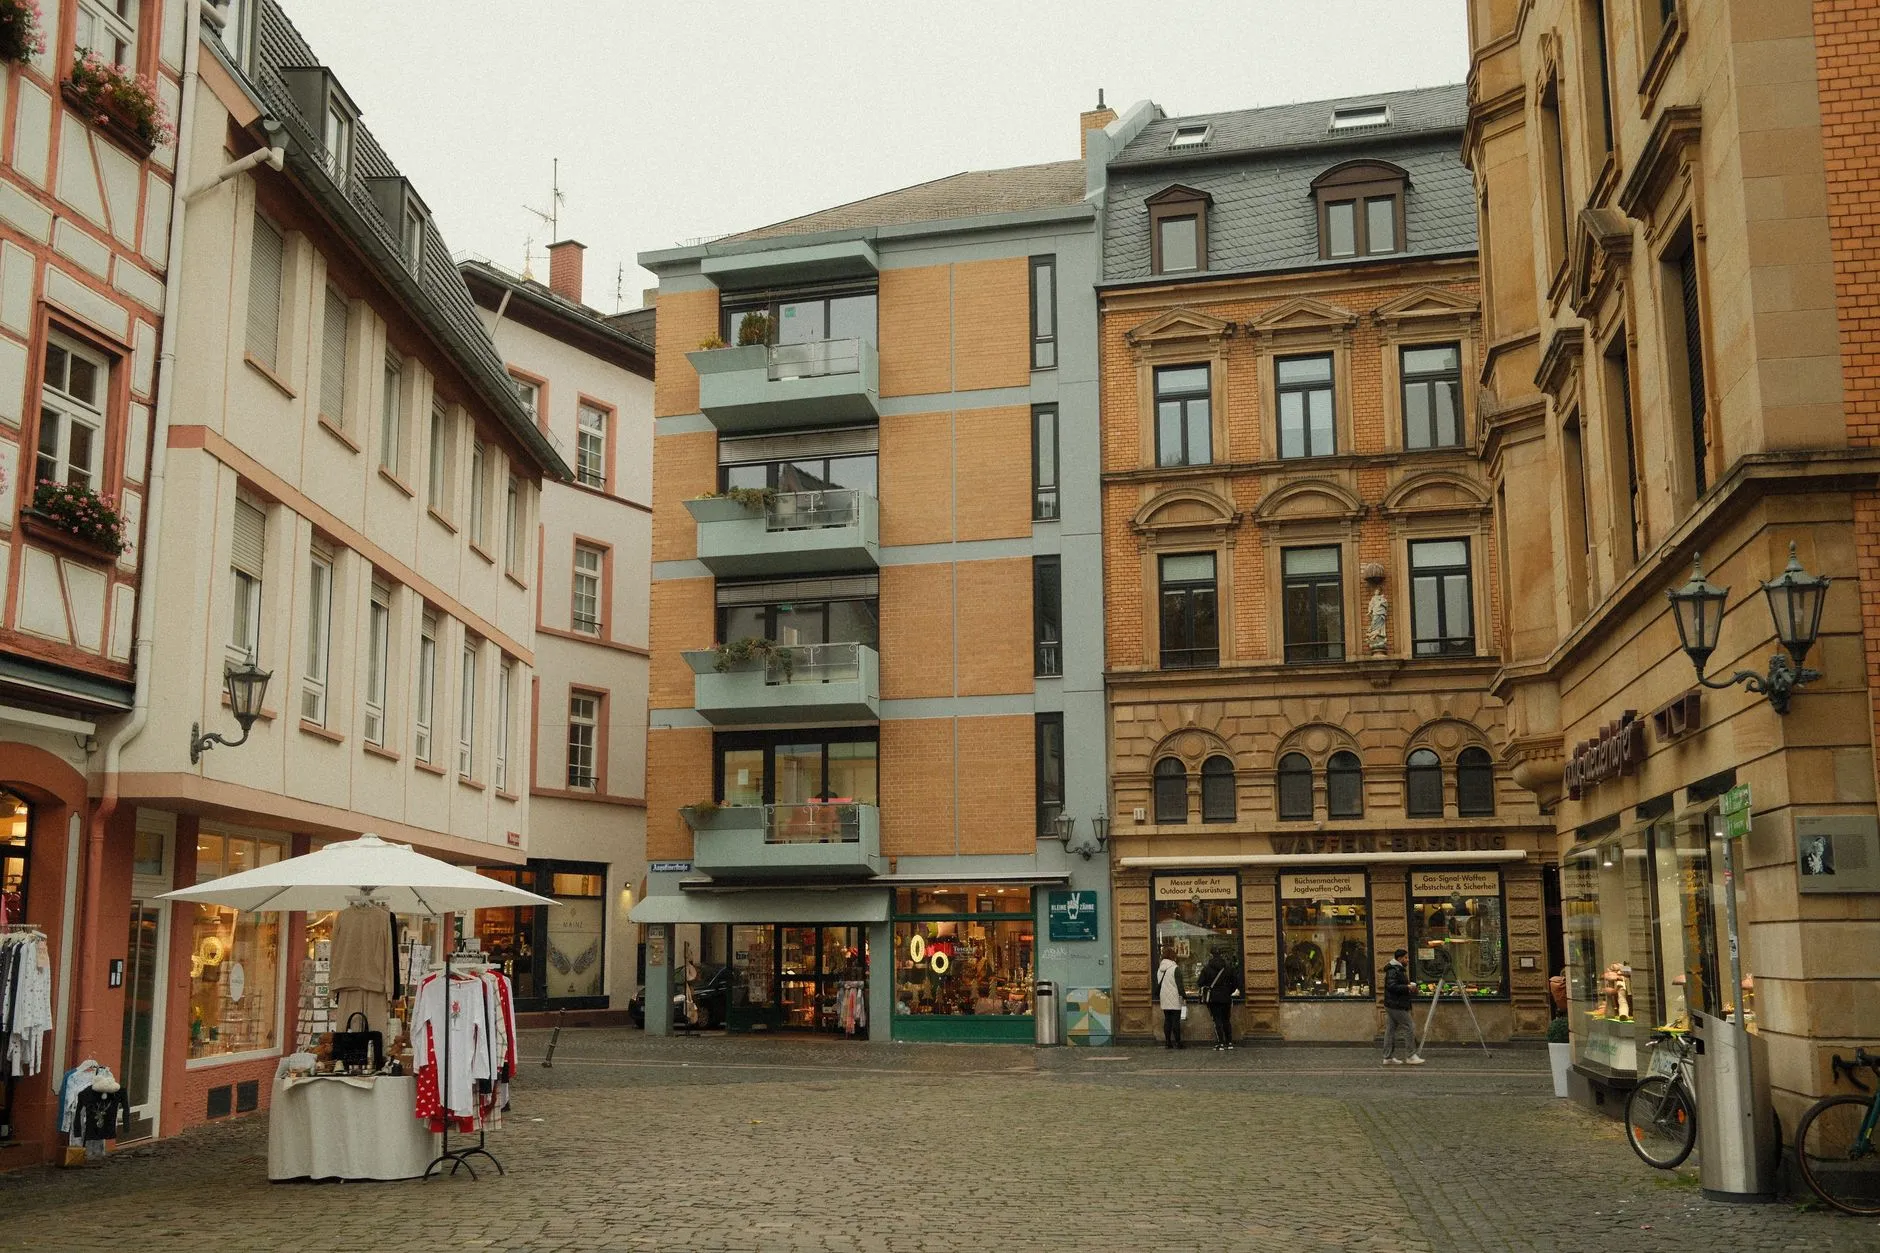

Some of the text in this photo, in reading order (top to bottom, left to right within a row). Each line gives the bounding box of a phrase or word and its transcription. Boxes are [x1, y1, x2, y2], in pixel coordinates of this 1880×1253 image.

[1194, 878, 1208, 886] aller
[1422, 874, 1487, 883] Gas-Signal-Waffen
[1293, 885, 1352, 894] Jagdwaffen-Optik
[1414, 883, 1453, 891] Selbstschutz
[1463, 882, 1496, 890] Sicherheit
